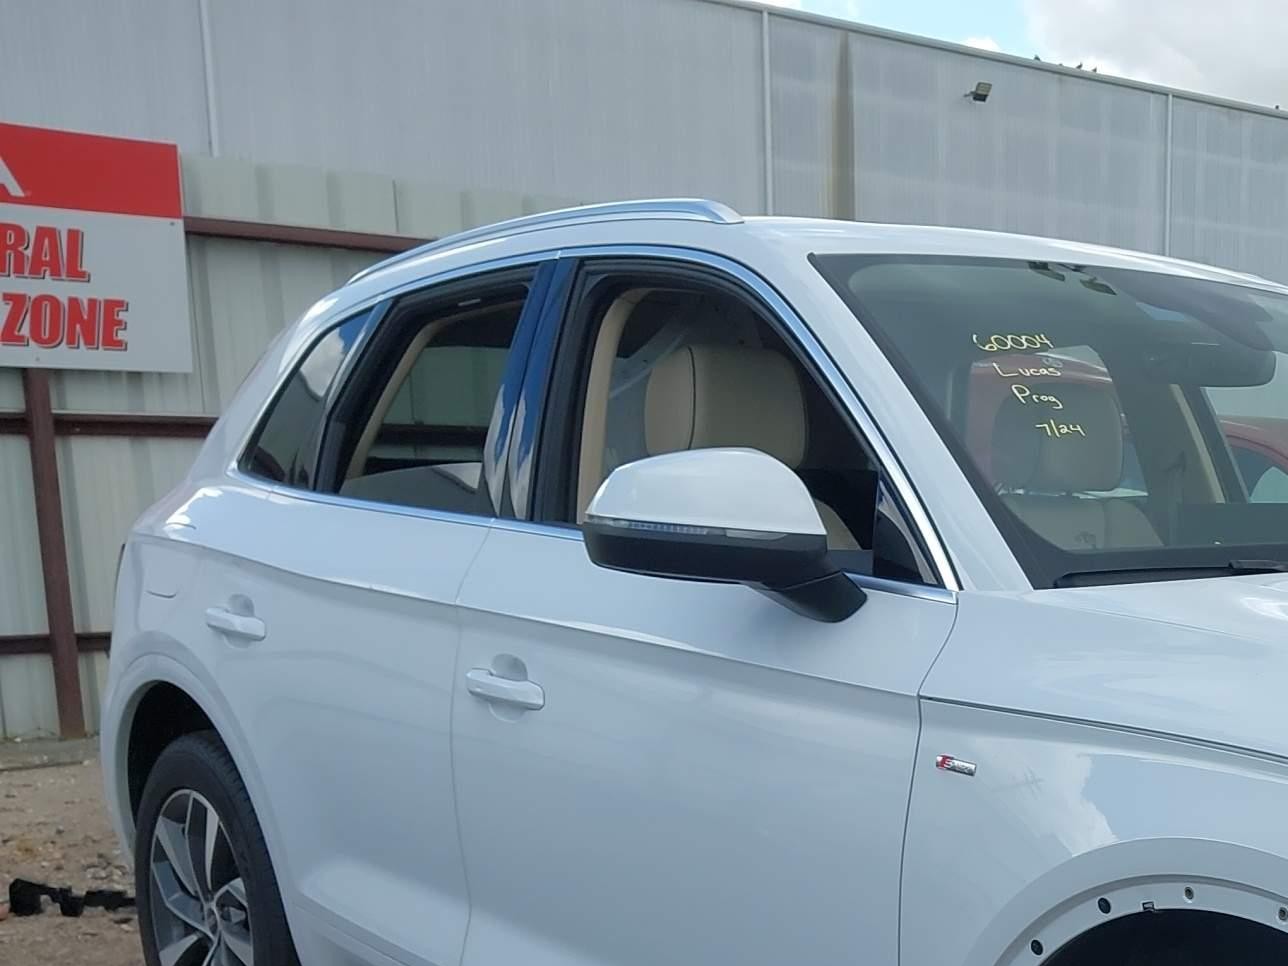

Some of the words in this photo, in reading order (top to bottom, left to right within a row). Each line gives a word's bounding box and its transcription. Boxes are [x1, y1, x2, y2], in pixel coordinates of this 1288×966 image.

[1, 292, 128, 351] ZONE
[972, 333, 1054, 352] 60004
[992, 362, 1062, 378] Lucas
[1011, 384, 1063, 410] Prog
[1036, 418, 1086, 438] 7/24
